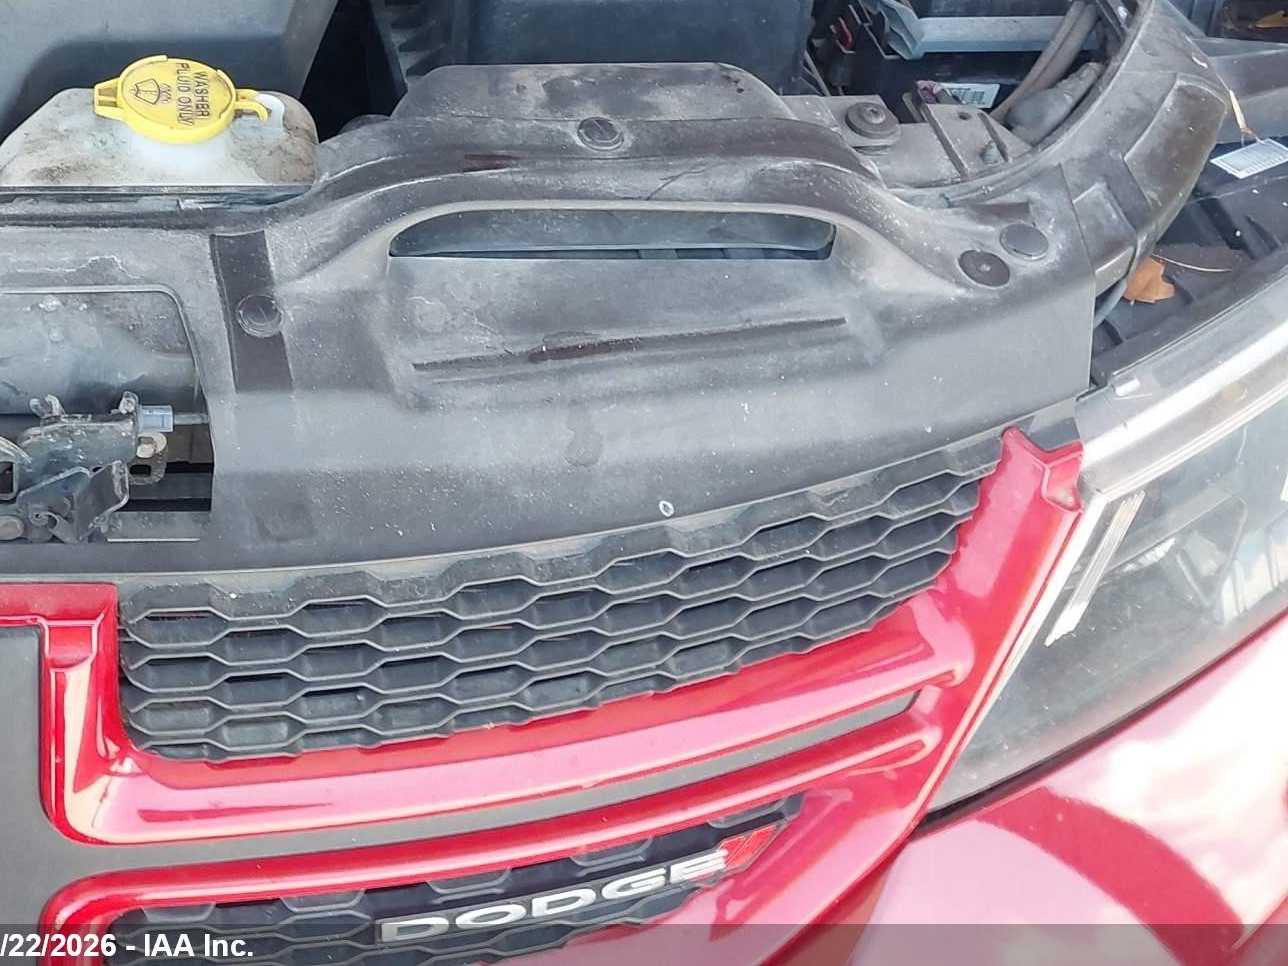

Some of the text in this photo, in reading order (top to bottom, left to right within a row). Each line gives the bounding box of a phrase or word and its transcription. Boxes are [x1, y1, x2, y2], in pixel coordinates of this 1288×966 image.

[176, 62, 194, 126] FLUID ONLY
[192, 70, 210, 121] WASHER
[381, 848, 728, 943] DODGE
